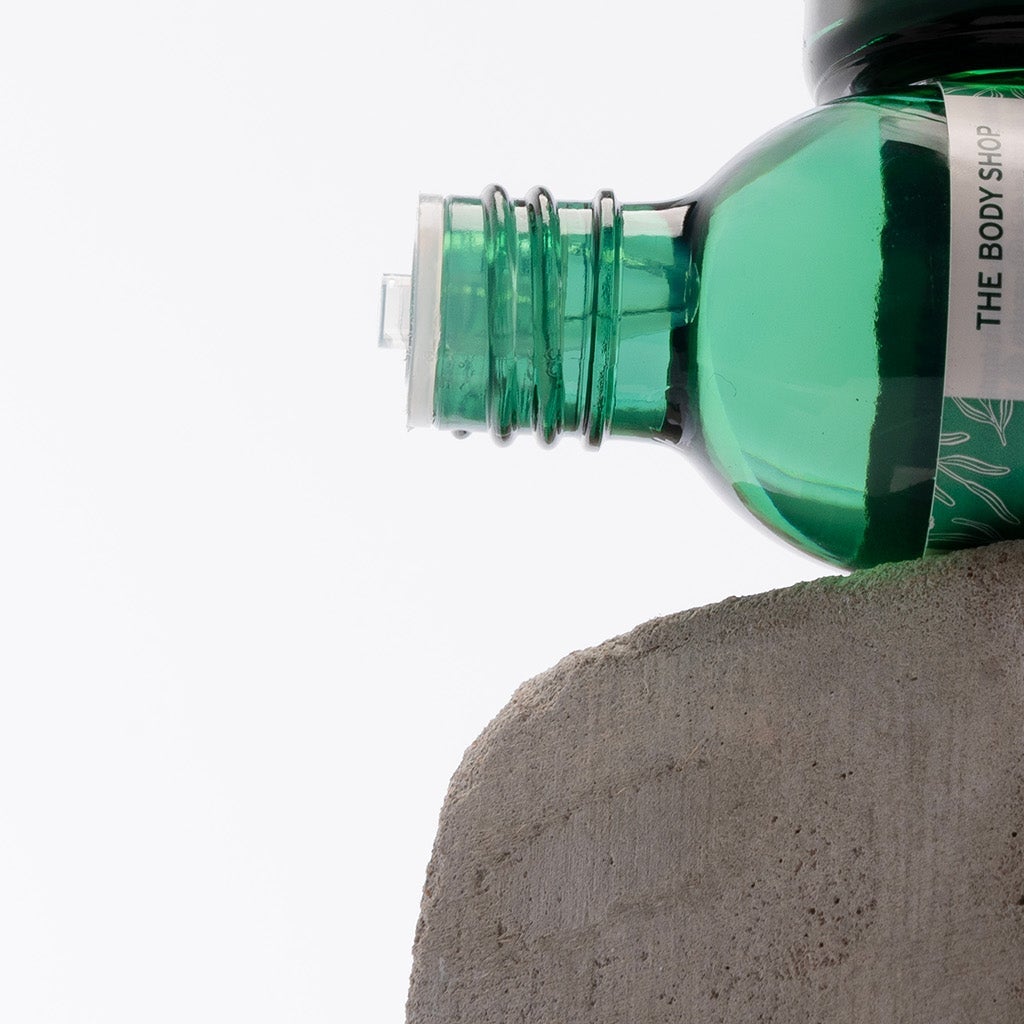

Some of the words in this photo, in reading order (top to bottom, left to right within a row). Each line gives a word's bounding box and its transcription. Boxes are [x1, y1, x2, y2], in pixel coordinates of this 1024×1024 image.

[977, 126, 1003, 181] SHOP
[979, 186, 1003, 260] BODY
[976, 272, 1002, 330] THE
